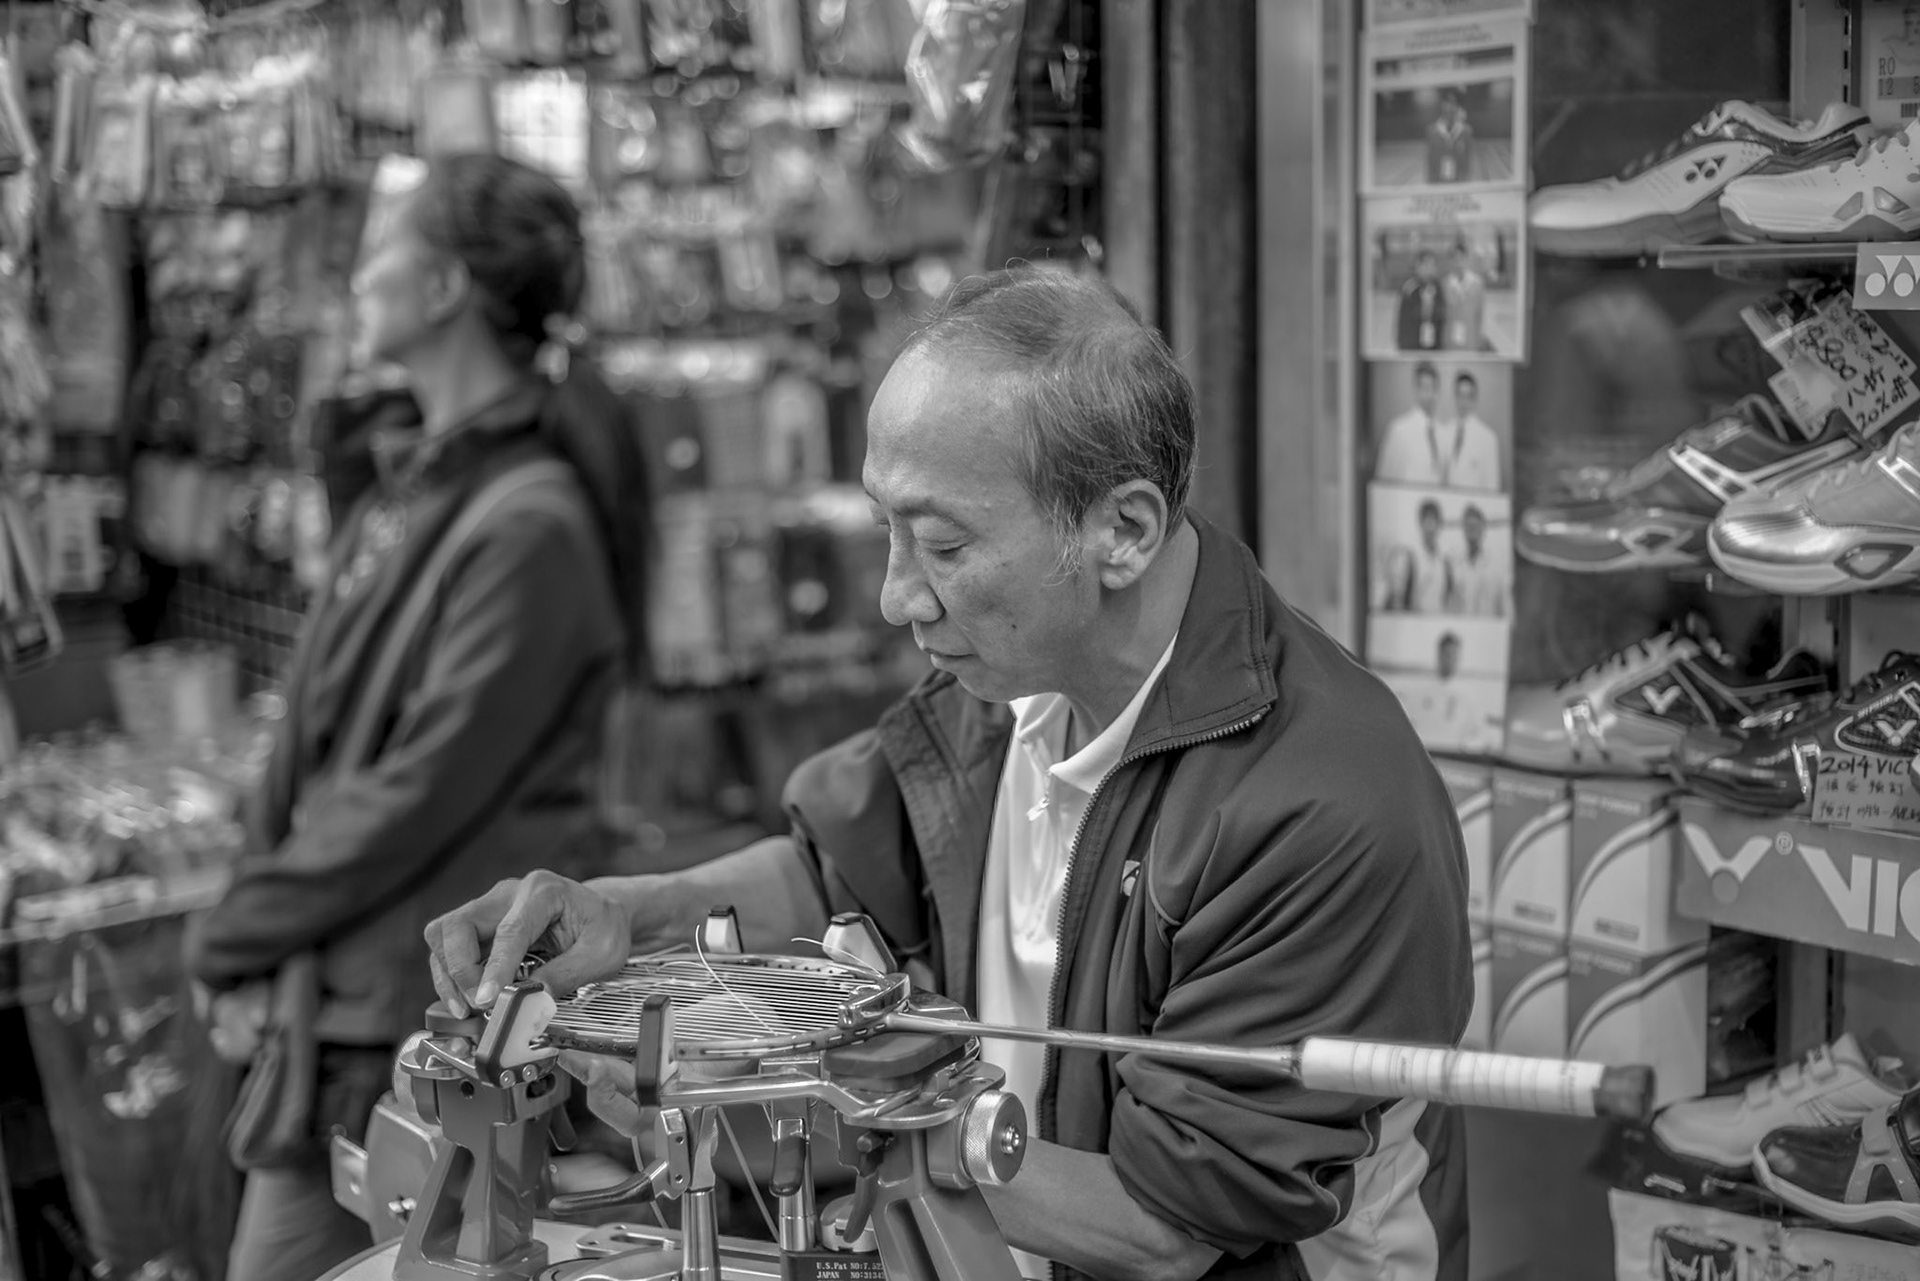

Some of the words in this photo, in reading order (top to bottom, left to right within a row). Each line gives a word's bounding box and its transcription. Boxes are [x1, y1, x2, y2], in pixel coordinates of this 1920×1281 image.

[1819, 755, 1872, 779] 2014
[1797, 843, 1920, 940] VI
[816, 1271, 840, 1279] JAPAN
